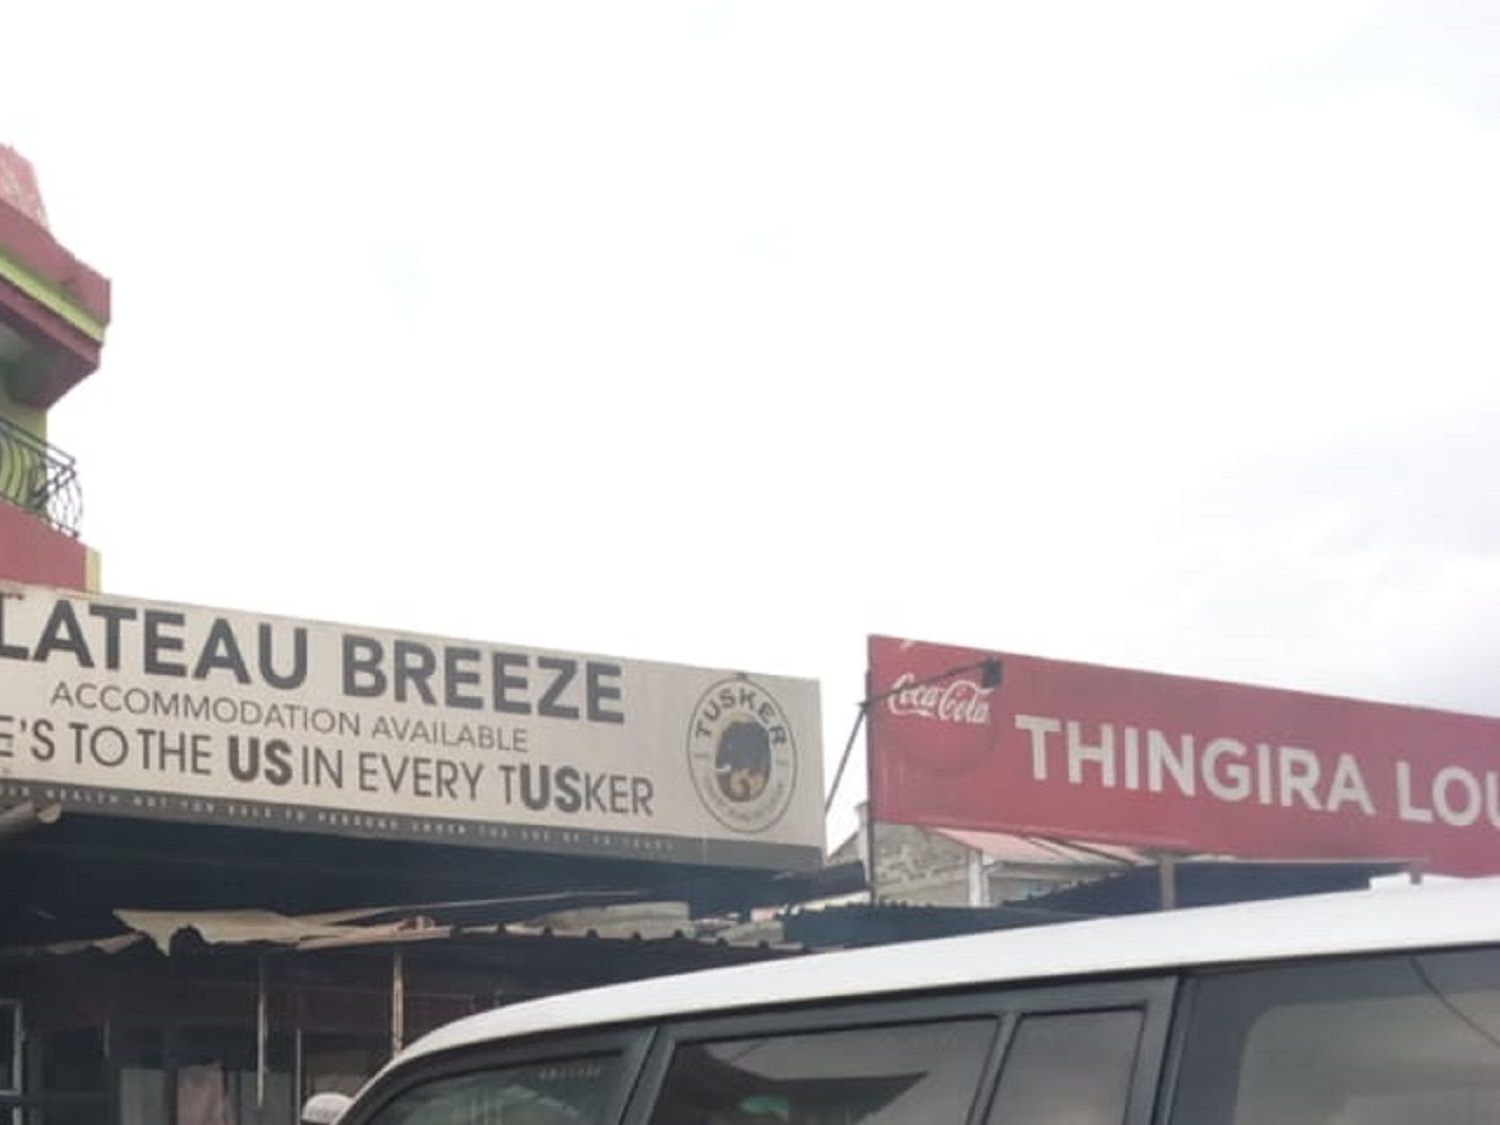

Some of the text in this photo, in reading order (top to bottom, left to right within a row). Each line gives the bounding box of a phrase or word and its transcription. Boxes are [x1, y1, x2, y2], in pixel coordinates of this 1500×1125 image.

[50, 680, 529, 754] ACCOMMODATION AVAILABLE
[341, 632, 626, 724] BREEZE
[695, 687, 787, 745] TUSKER
[70, 722, 129, 768] TO
[137, 728, 212, 776] THE
[228, 735, 293, 787] US
[301, 745, 343, 790] IN
[359, 750, 484, 801] EVERY
[504, 762, 655, 818] TUSKER
[1014, 713, 1375, 817] THINGIRA
